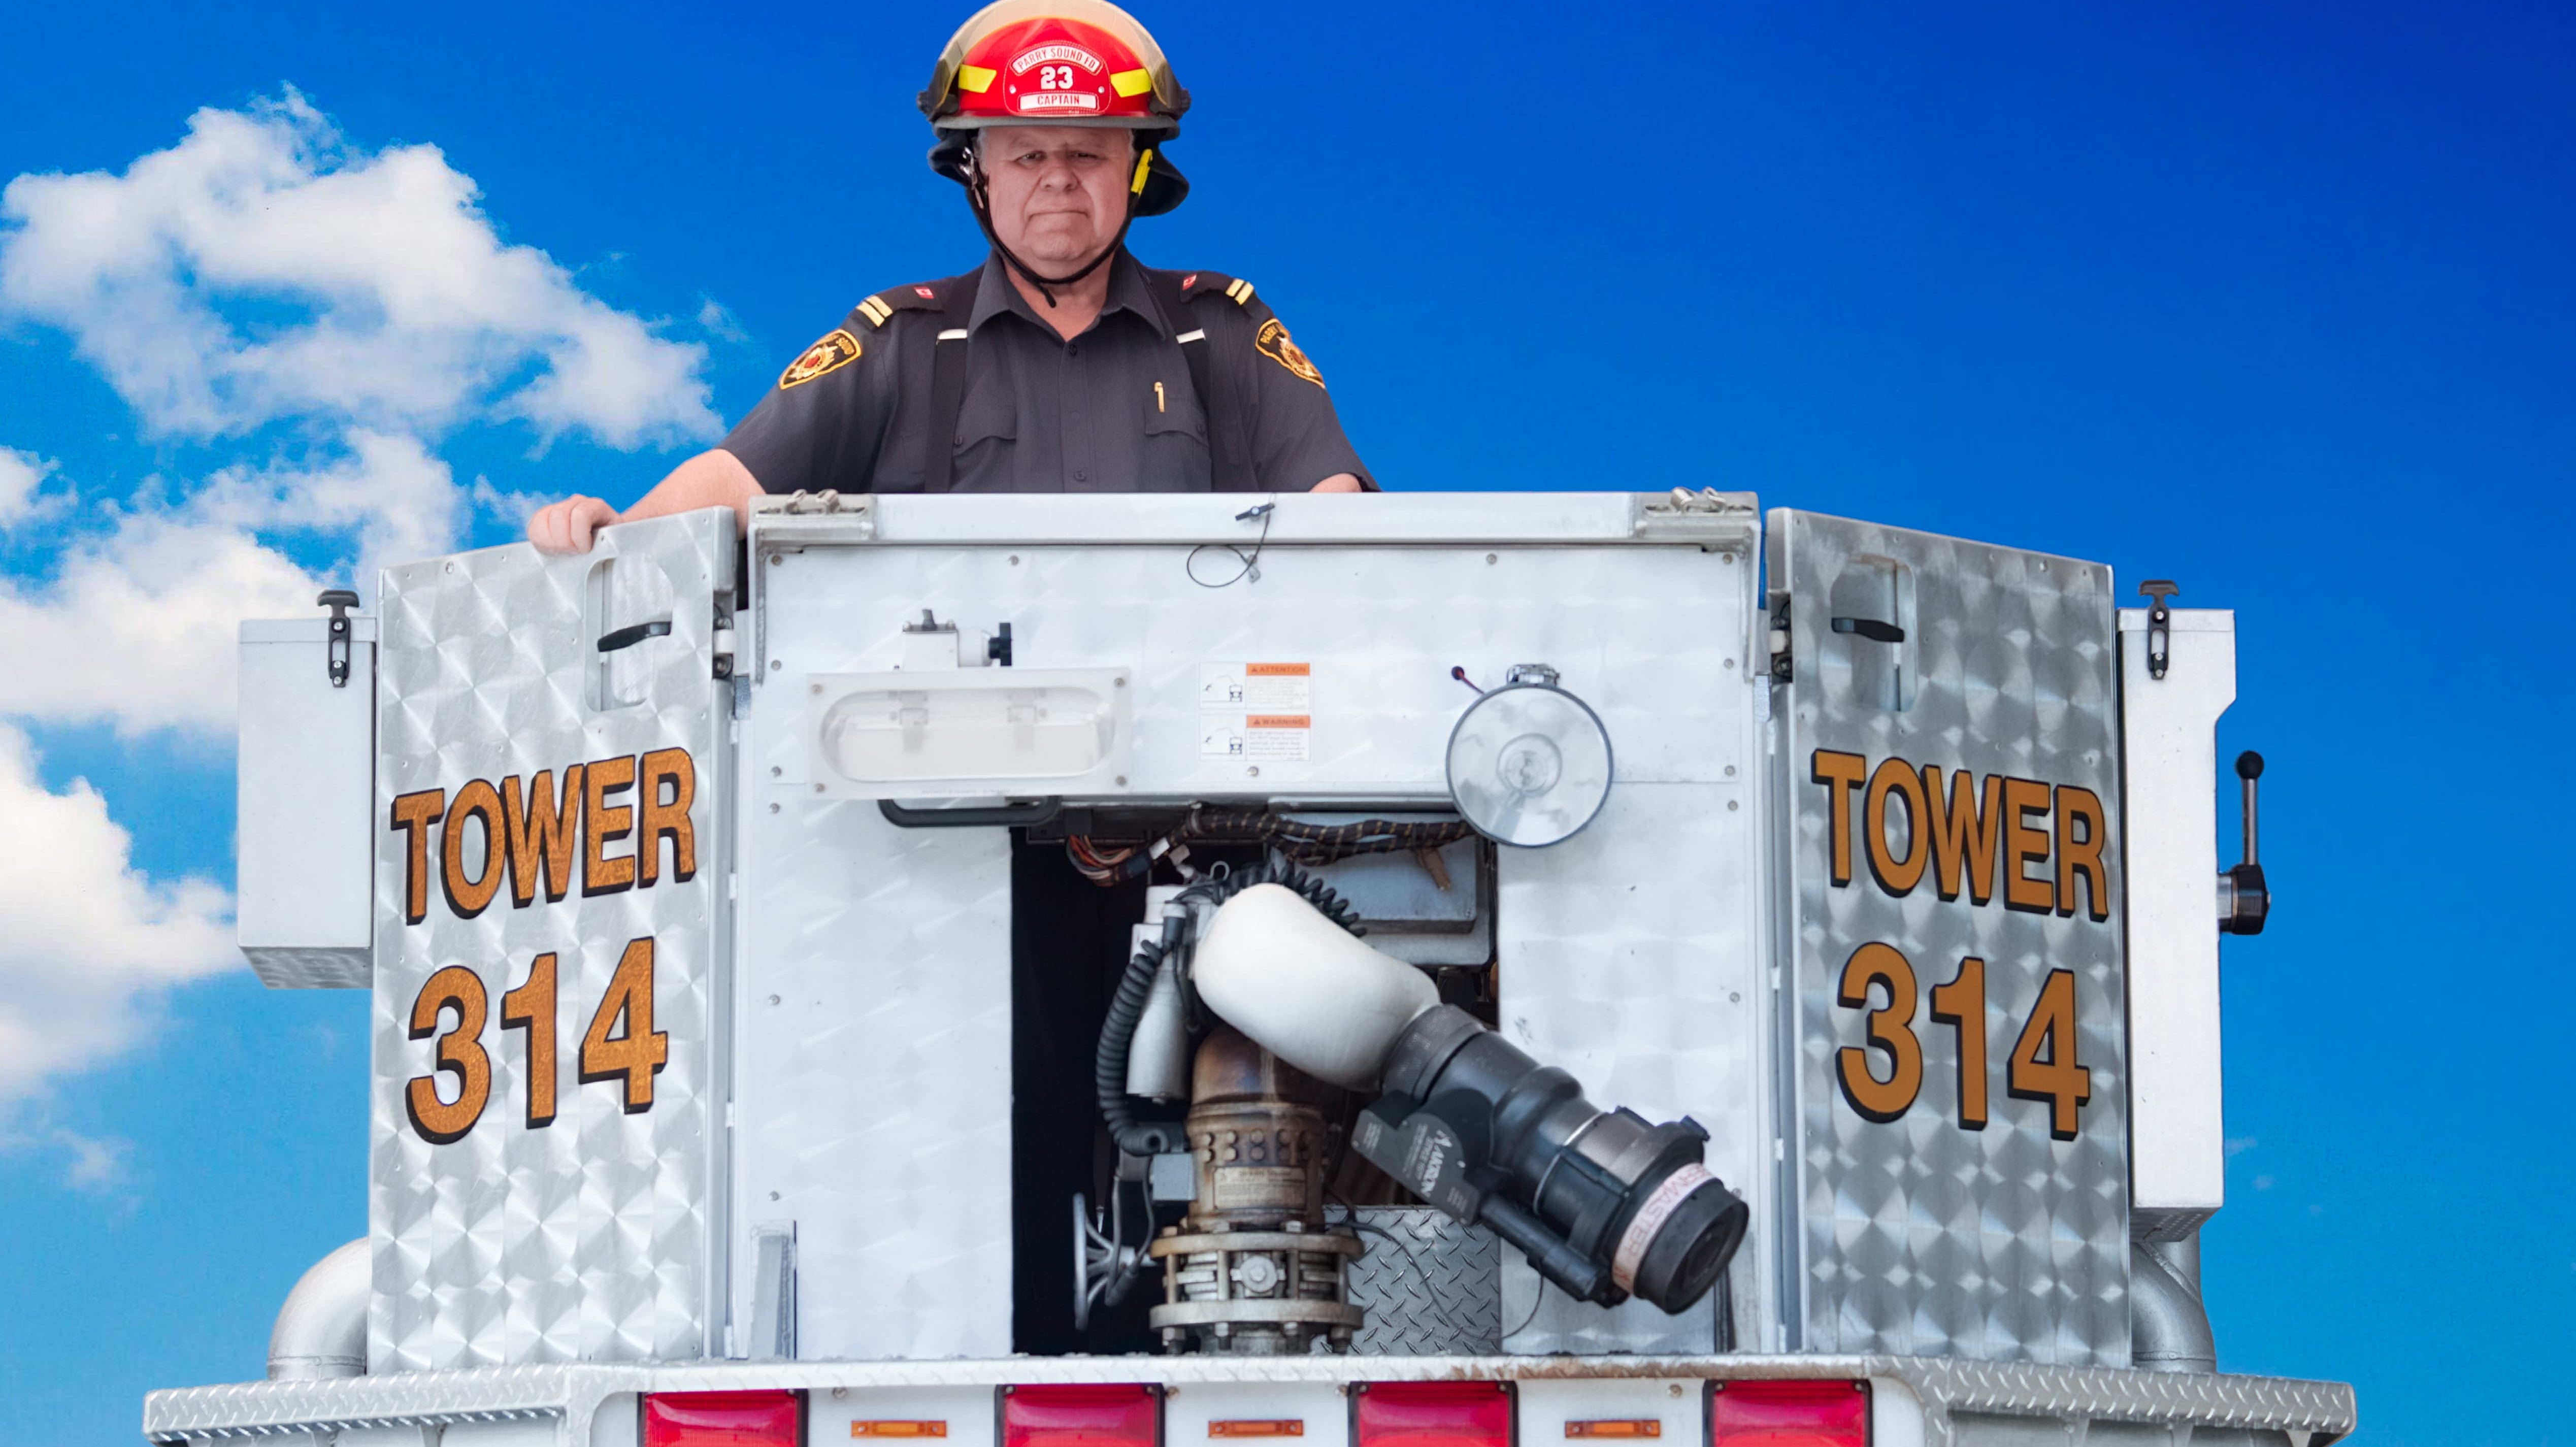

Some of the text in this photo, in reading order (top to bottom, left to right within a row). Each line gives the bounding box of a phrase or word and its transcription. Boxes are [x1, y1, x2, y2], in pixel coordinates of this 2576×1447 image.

[1017, 48, 1095, 70] PARRY SOUND FD
[1037, 95, 1080, 105] CAPTAIN
[1041, 66, 1073, 89] 23
[391, 747, 696, 925] TOWER
[1810, 748, 2109, 923] TOWER
[405, 936, 668, 1145] 314
[1835, 941, 2091, 1142] 314
[1420, 1143, 1445, 1198] AKRON
